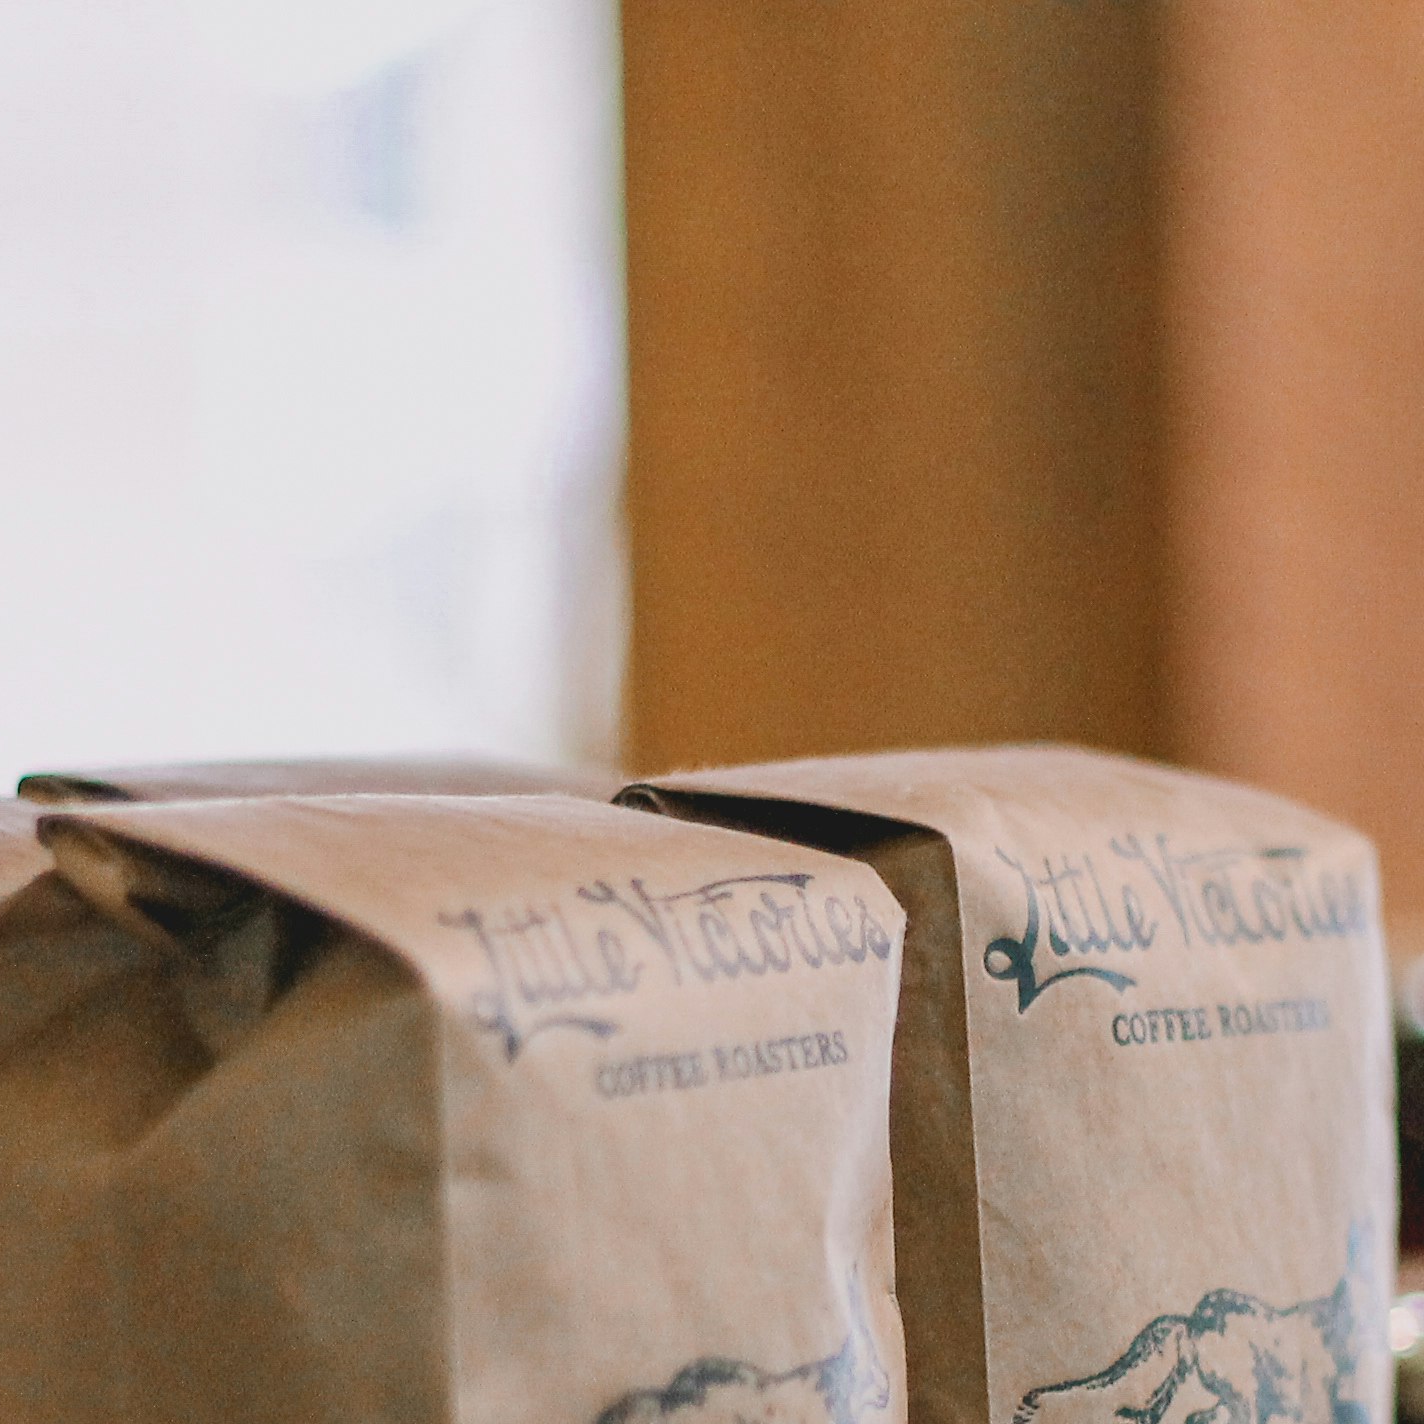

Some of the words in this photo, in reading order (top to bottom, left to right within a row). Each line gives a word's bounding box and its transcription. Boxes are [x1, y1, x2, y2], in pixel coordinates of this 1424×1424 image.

[1111, 1007, 1213, 1047] COFFEE
[595, 1050, 710, 1100] COFFEE
[712, 1029, 850, 1082] ROASTERS
